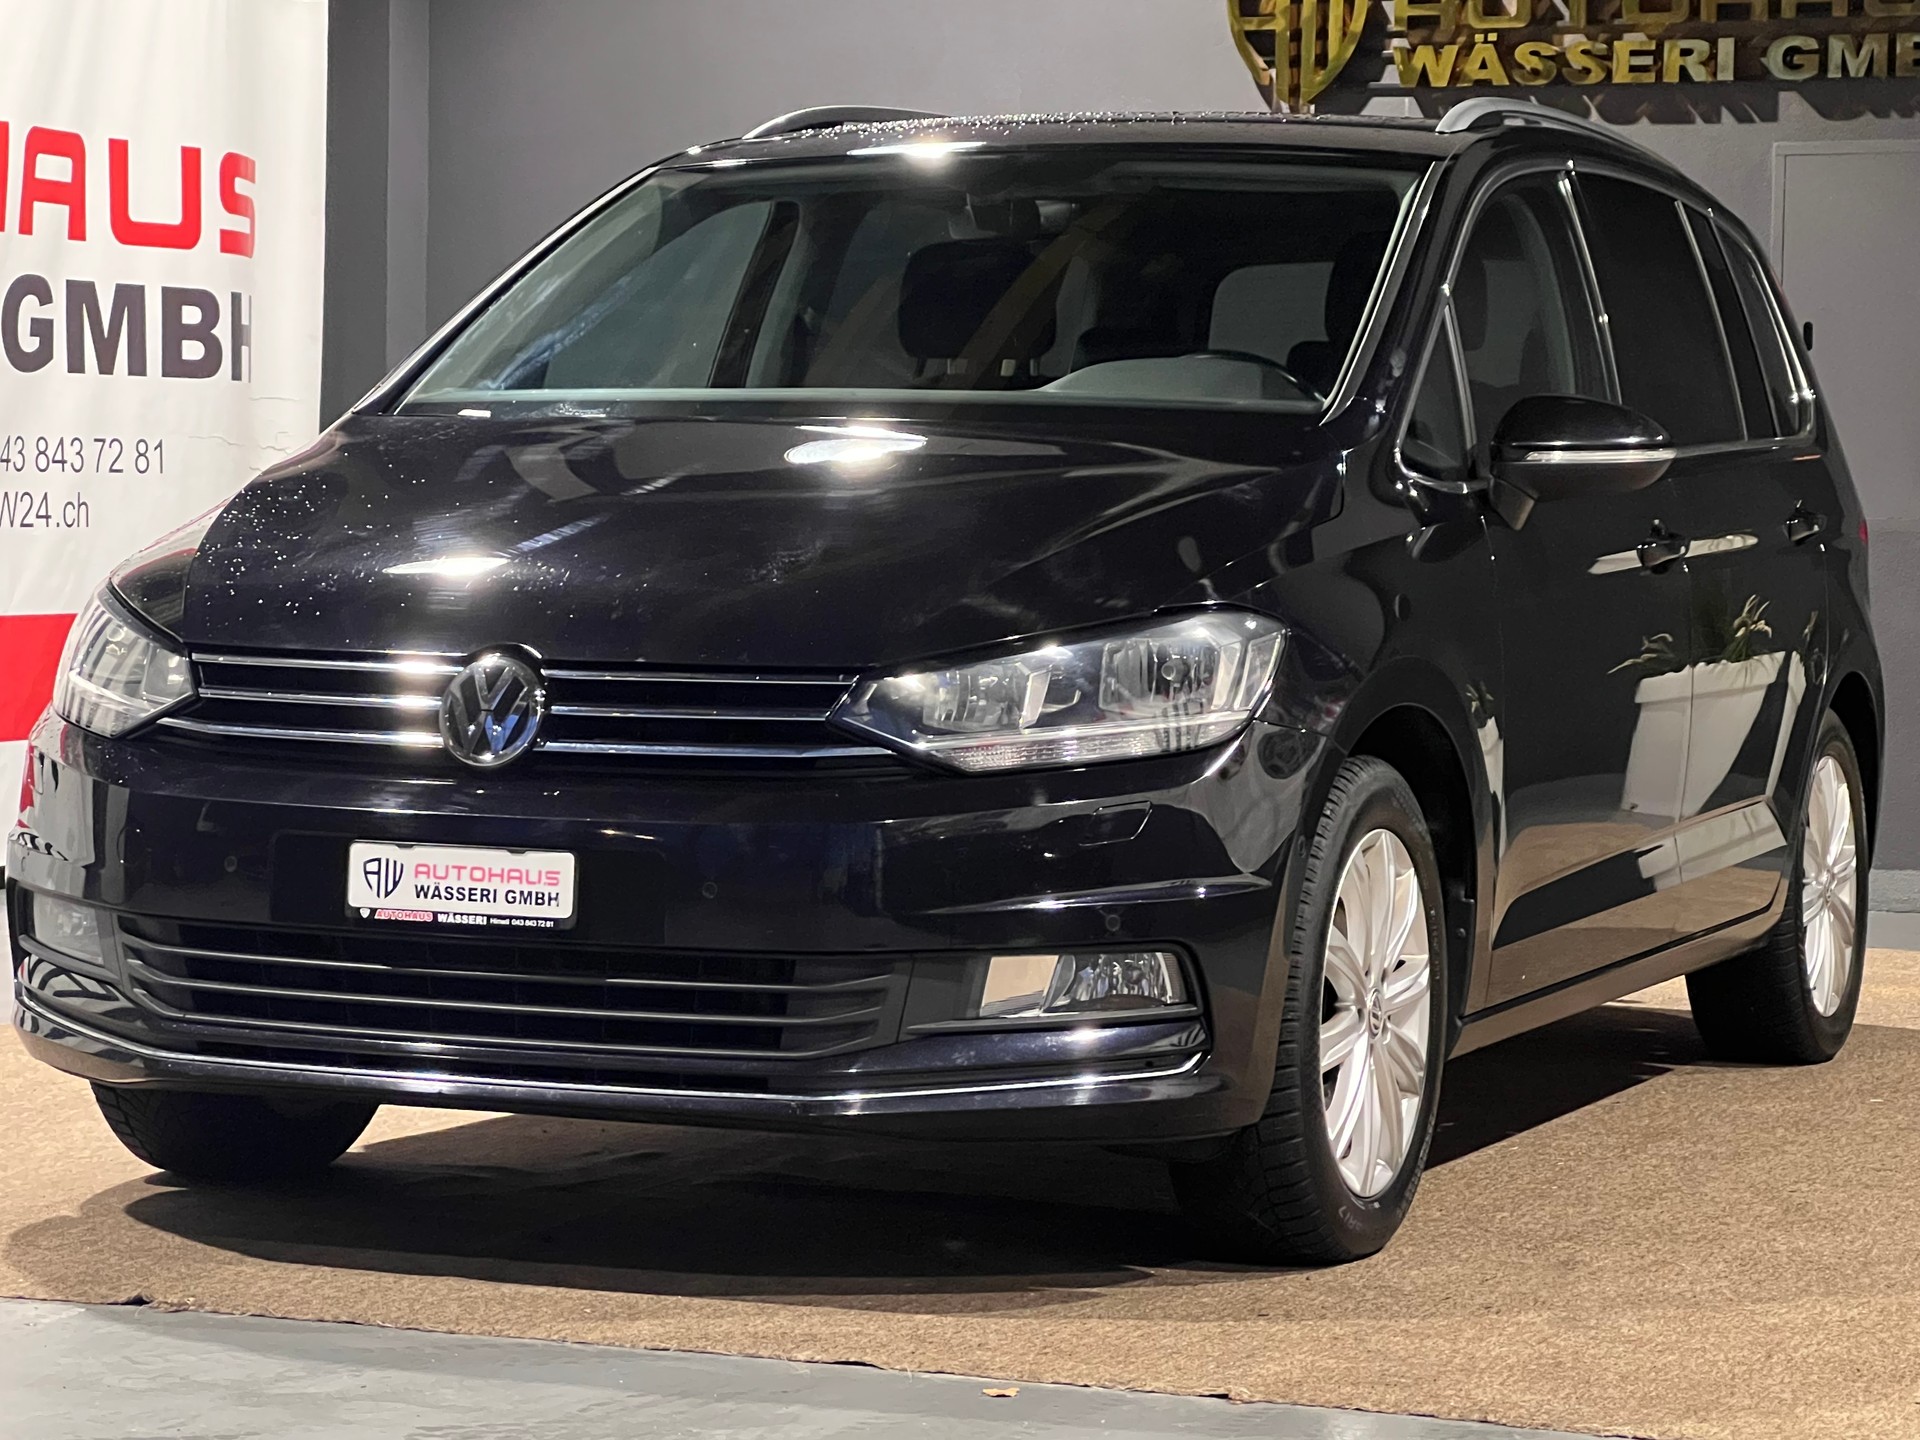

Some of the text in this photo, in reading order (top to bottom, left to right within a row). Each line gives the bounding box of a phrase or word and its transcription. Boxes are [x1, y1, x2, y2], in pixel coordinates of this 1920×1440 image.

[1394, 33, 1735, 88] WÄSSERI
[1, 273, 252, 383] GMBH
[35, 436, 84, 473] 843
[93, 437, 124, 474] 72
[135, 438, 164, 474] 81
[413, 863, 561, 887] AUTOHAUS
[414, 882, 560, 907] WÄSSERI GMBH
[375, 909, 433, 921] AUTOHAUS
